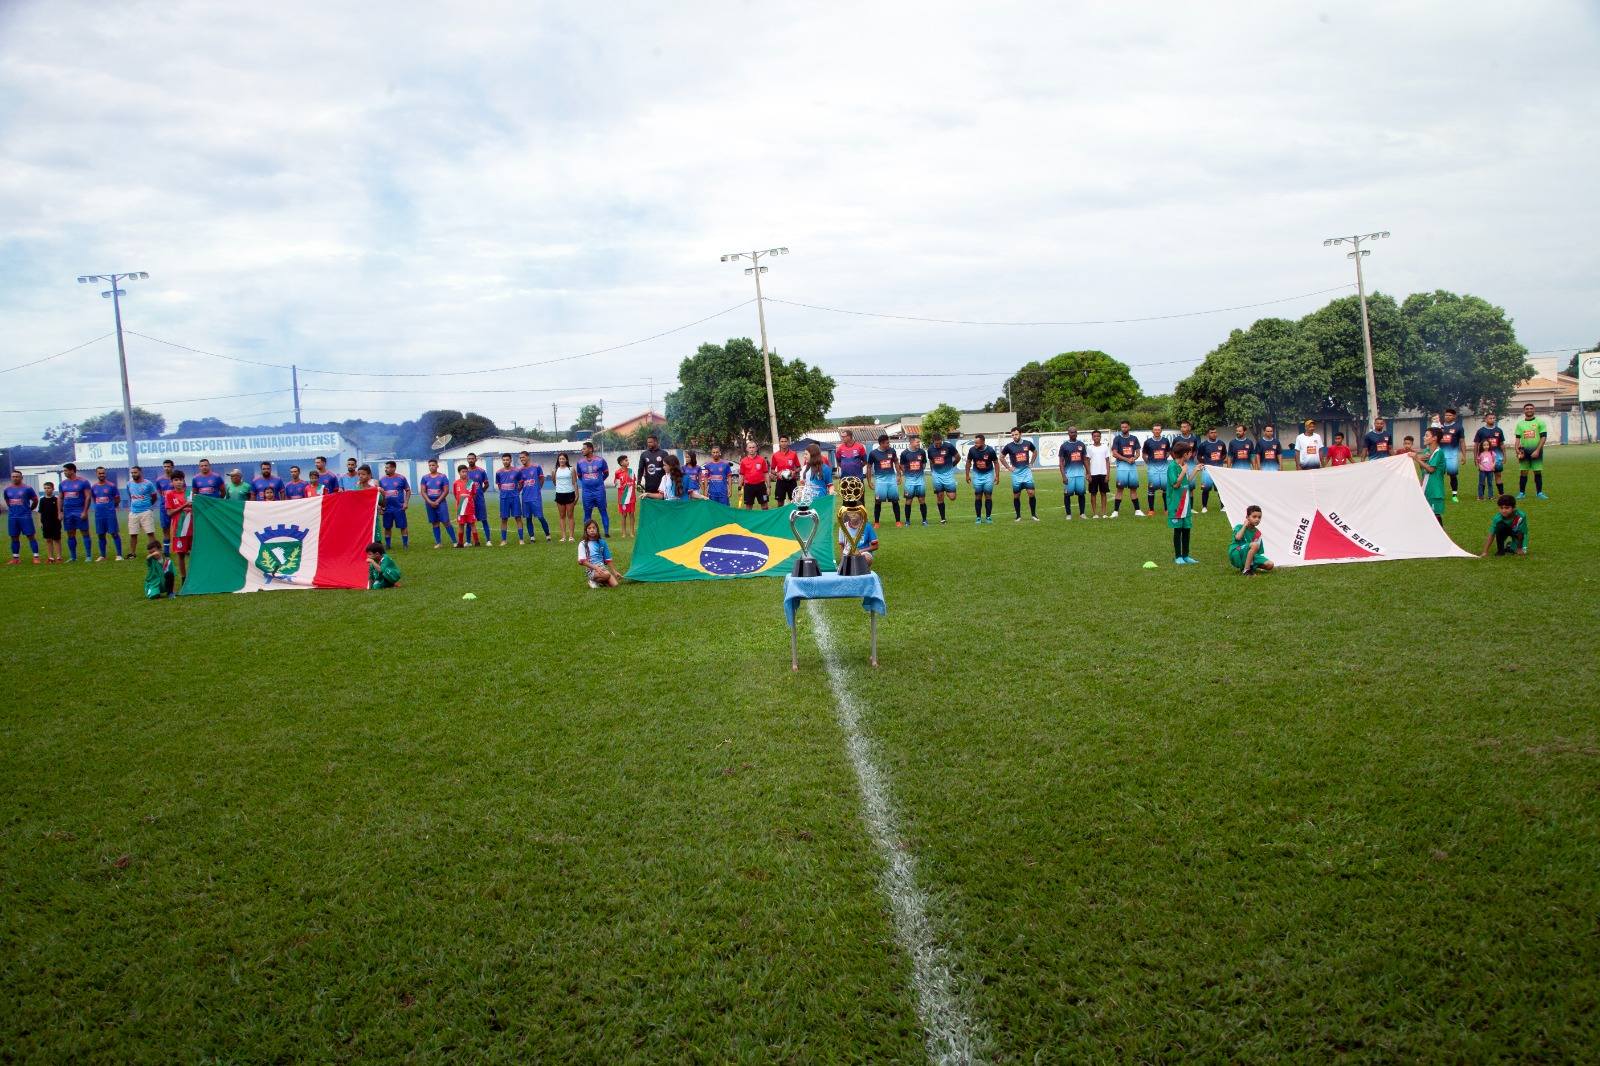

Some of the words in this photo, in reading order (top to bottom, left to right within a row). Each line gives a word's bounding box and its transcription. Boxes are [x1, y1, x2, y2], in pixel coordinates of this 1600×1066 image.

[182, 438, 246, 452] DESPORTIVA
[249, 433, 337, 449] INDIANOPOLENSE
[1293, 518, 1309, 555] LIBERTAS
[1351, 532, 1380, 553] SERA
